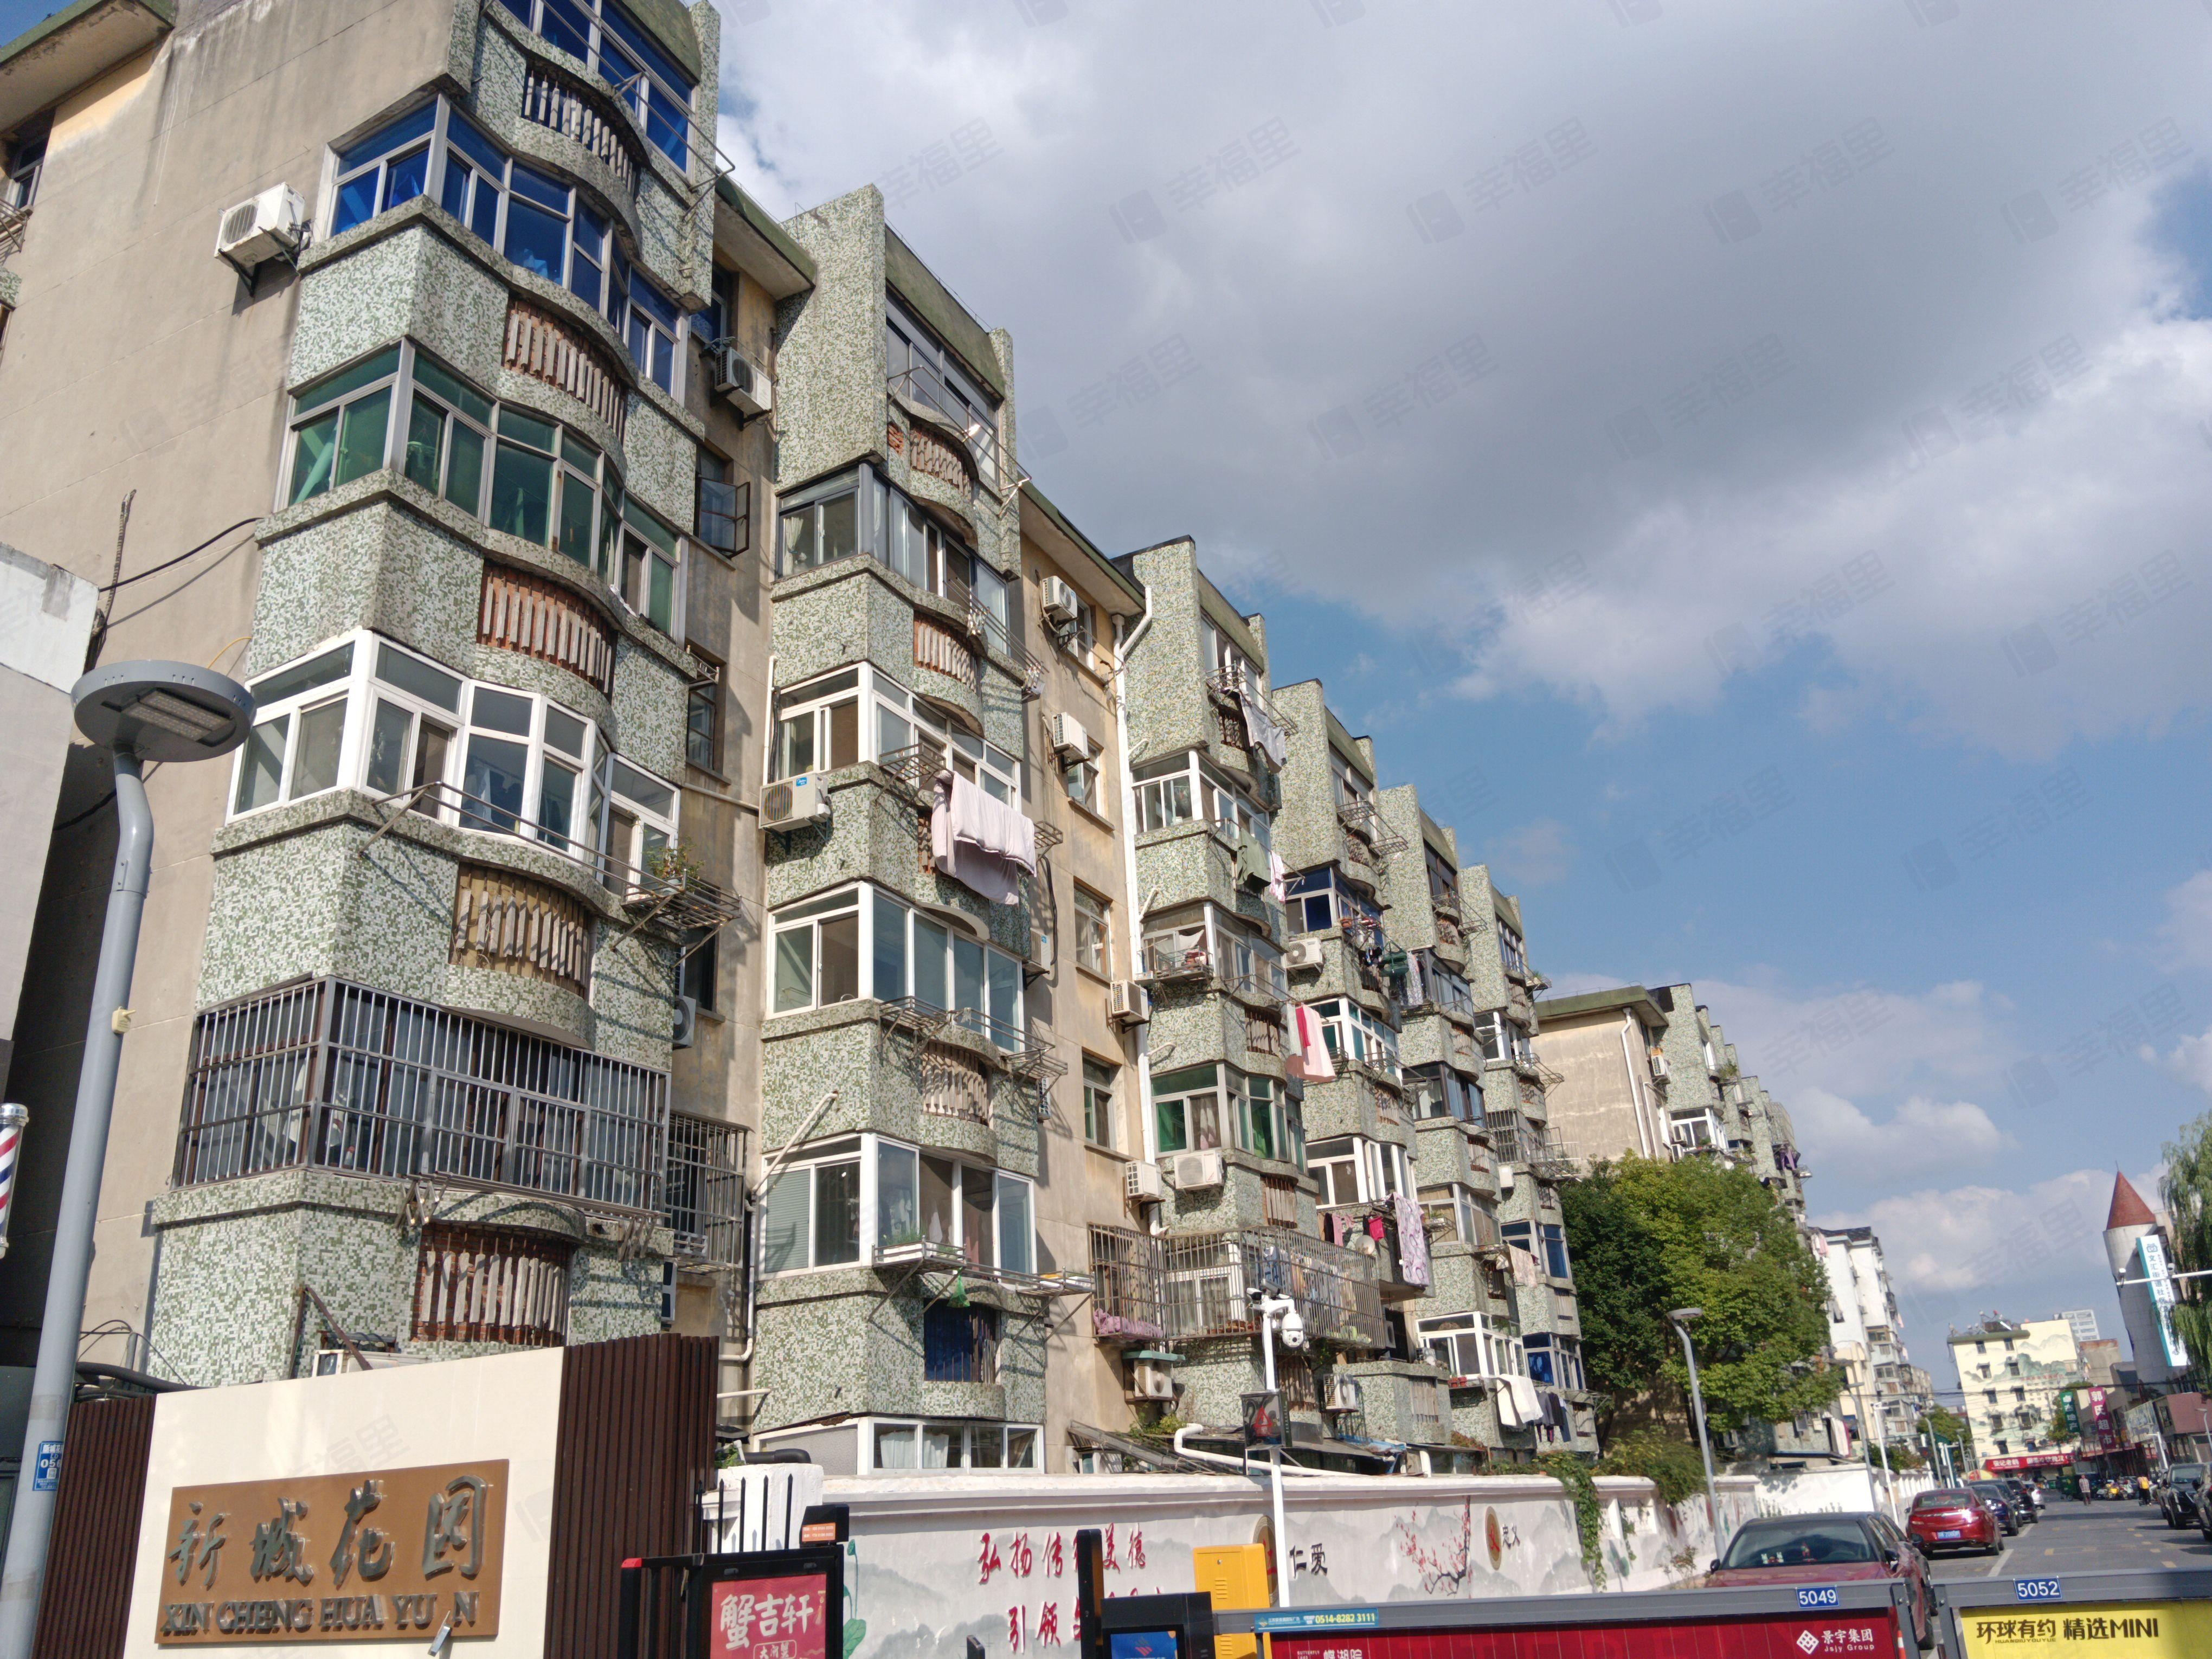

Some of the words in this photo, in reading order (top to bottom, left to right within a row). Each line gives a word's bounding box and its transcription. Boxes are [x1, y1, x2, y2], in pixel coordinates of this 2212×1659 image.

[2091, 1391, 2112, 1445] 郭氏超市
[168, 1475, 490, 1589] 新城花园
[978, 1522, 1146, 1584] 弘扬传美德
[1290, 1544, 1327, 1578] 仁爱
[1799, 1589, 1836, 1605] 5049
[2018, 1581, 2060, 1597] 5052
[161, 1602, 214, 1634] XIN
[216, 1598, 314, 1632] CHENG
[318, 1594, 385, 1630] HUA
[720, 1593, 813, 1649] 蟹吉轩
[1315, 1614, 1355, 1623] 0514-8282
[1357, 1613, 1375, 1622] 3111
[1976, 1618, 2056, 1644] 环球有约
[2063, 1617, 2158, 1641] 精选MINI
[1822, 1628, 1873, 1645] 景宇集团
